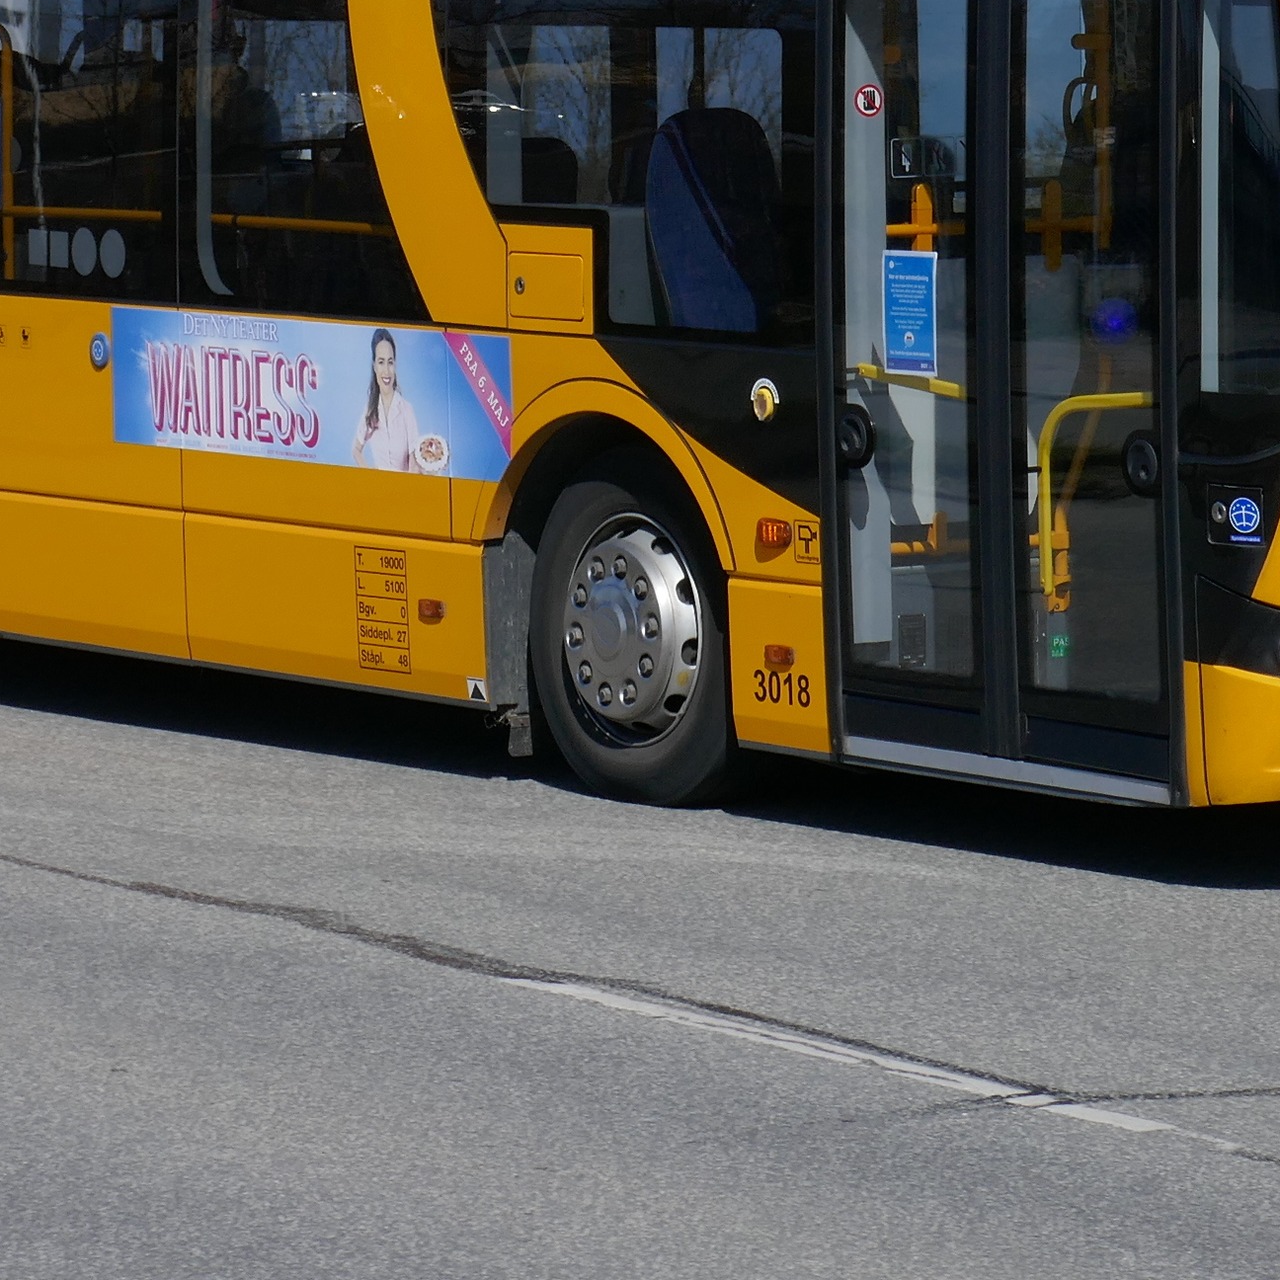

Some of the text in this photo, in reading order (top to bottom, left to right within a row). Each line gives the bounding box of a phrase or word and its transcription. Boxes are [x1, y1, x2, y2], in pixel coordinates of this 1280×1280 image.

[460, 342, 509, 427] FRA 6. MAJ
[146, 340, 319, 449] WAITRESS
[357, 553, 404, 570] T. 19000
[358, 577, 405, 594] L. 5100
[359, 601, 406, 618] Bgv. 0
[359, 625, 407, 643] Siddepl. 27
[361, 650, 408, 667] Ståpl. 48
[753, 669, 811, 708] 3018
